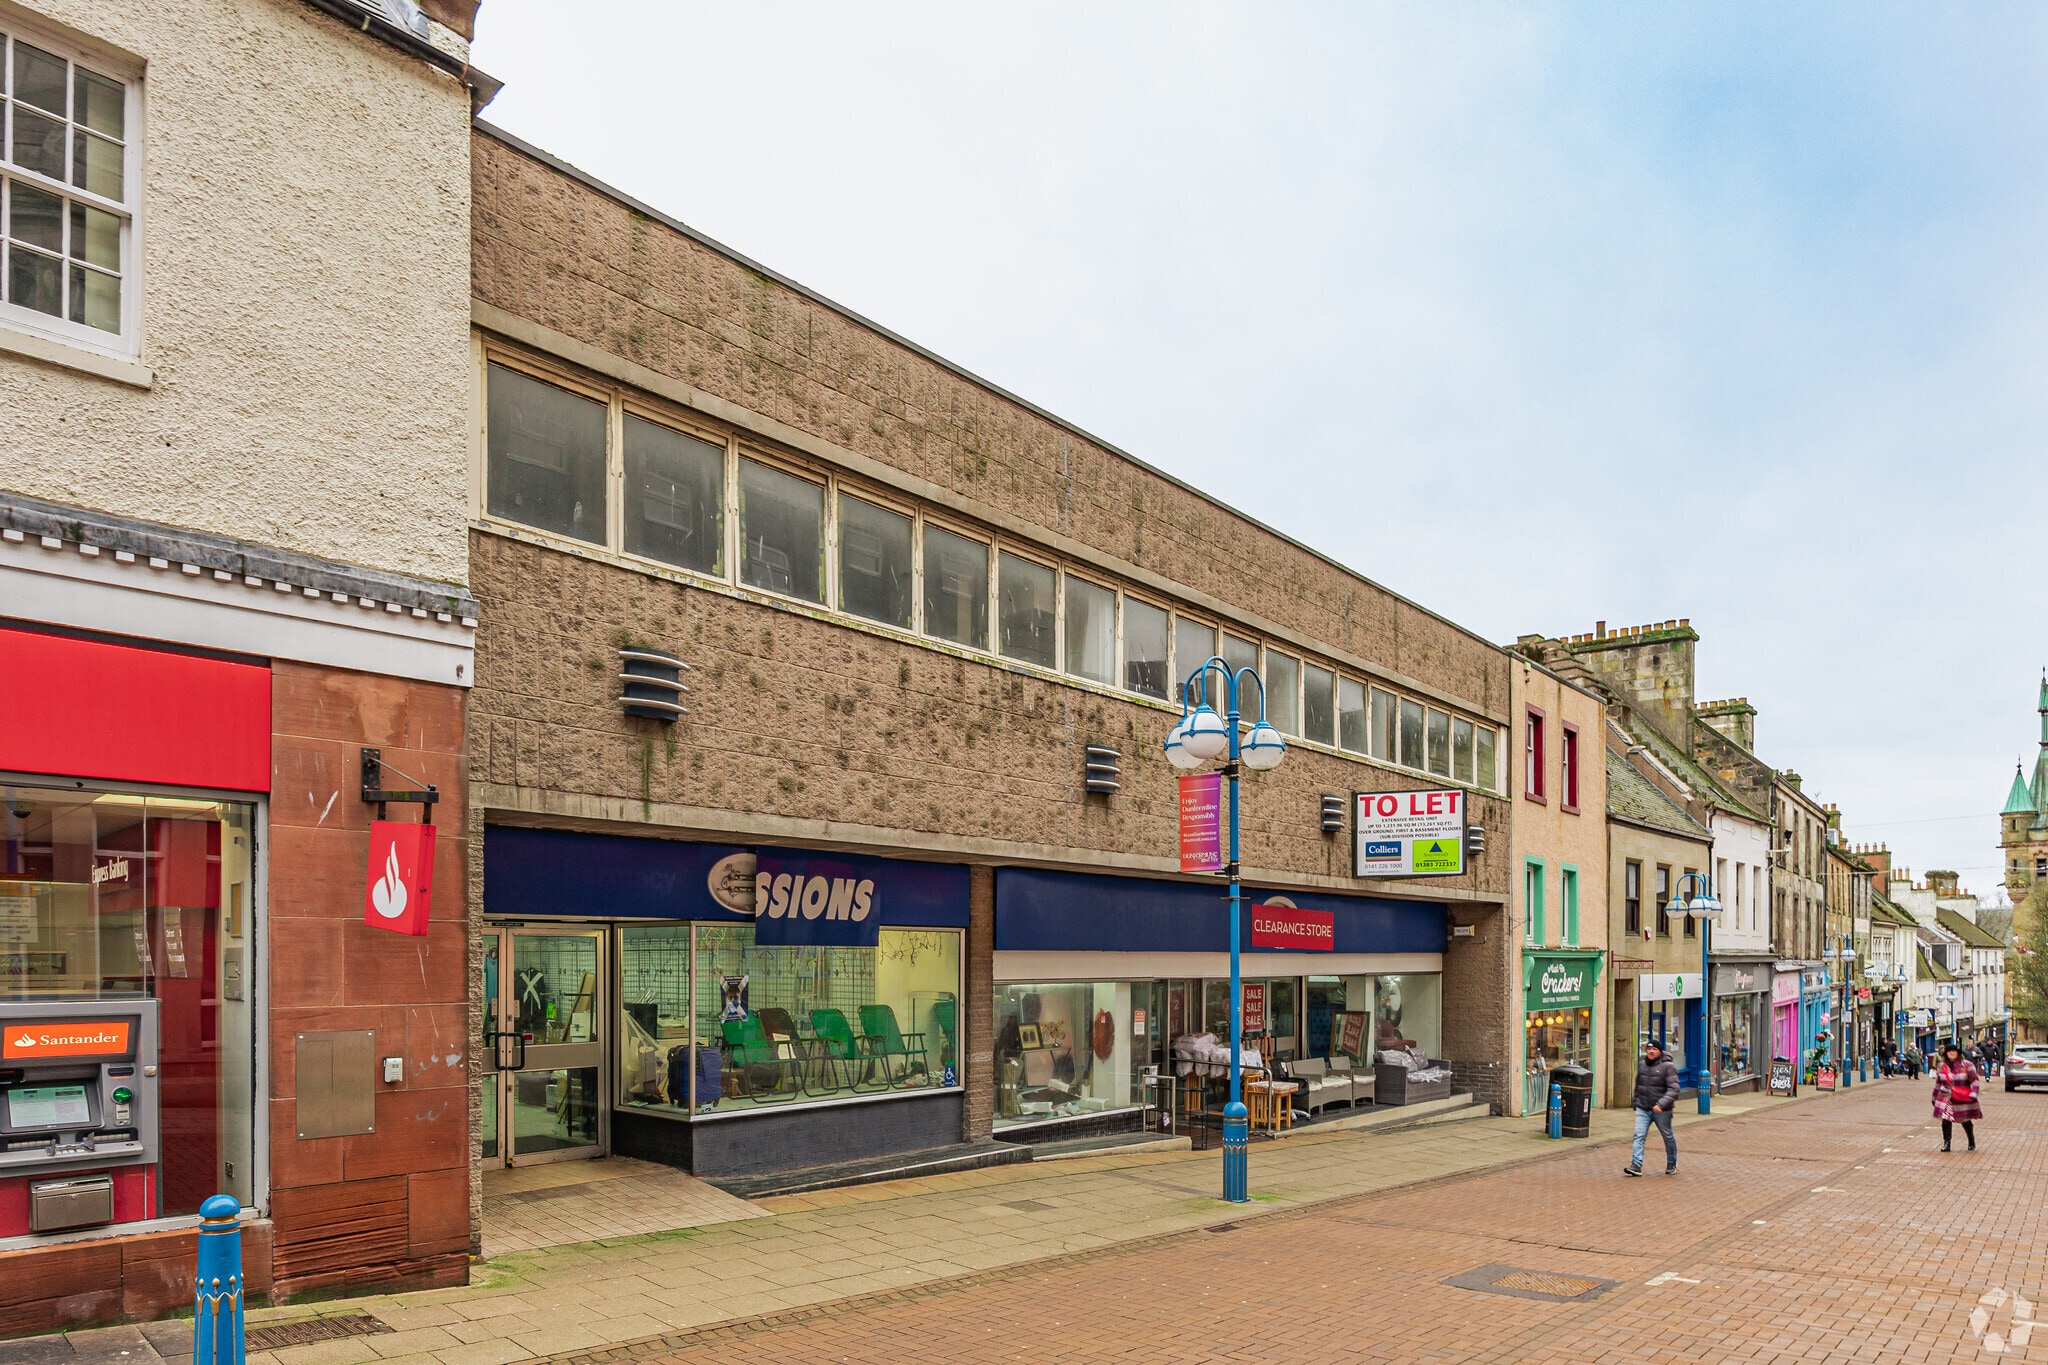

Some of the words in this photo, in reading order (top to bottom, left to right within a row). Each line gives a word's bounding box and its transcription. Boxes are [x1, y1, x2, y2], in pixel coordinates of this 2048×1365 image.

[1182, 804, 1217, 812] Dunfermline
[1360, 795, 1398, 818] TO
[1410, 792, 1461, 816] LET
[1182, 812, 1215, 821] Responsibly
[1369, 846, 1398, 854] Colliers
[92, 865, 108, 888] Express
[109, 856, 128, 882] Banking
[1254, 919, 1305, 935] CLEARANCE
[1306, 924, 1332, 937] STORE
[1542, 971, 1583, 994] Crackers!
[1246, 989, 1261, 999] SALE
[1246, 1002, 1261, 1012] SALE
[1246, 1016, 1261, 1026] SALE
[40, 1032, 118, 1046] Santander
